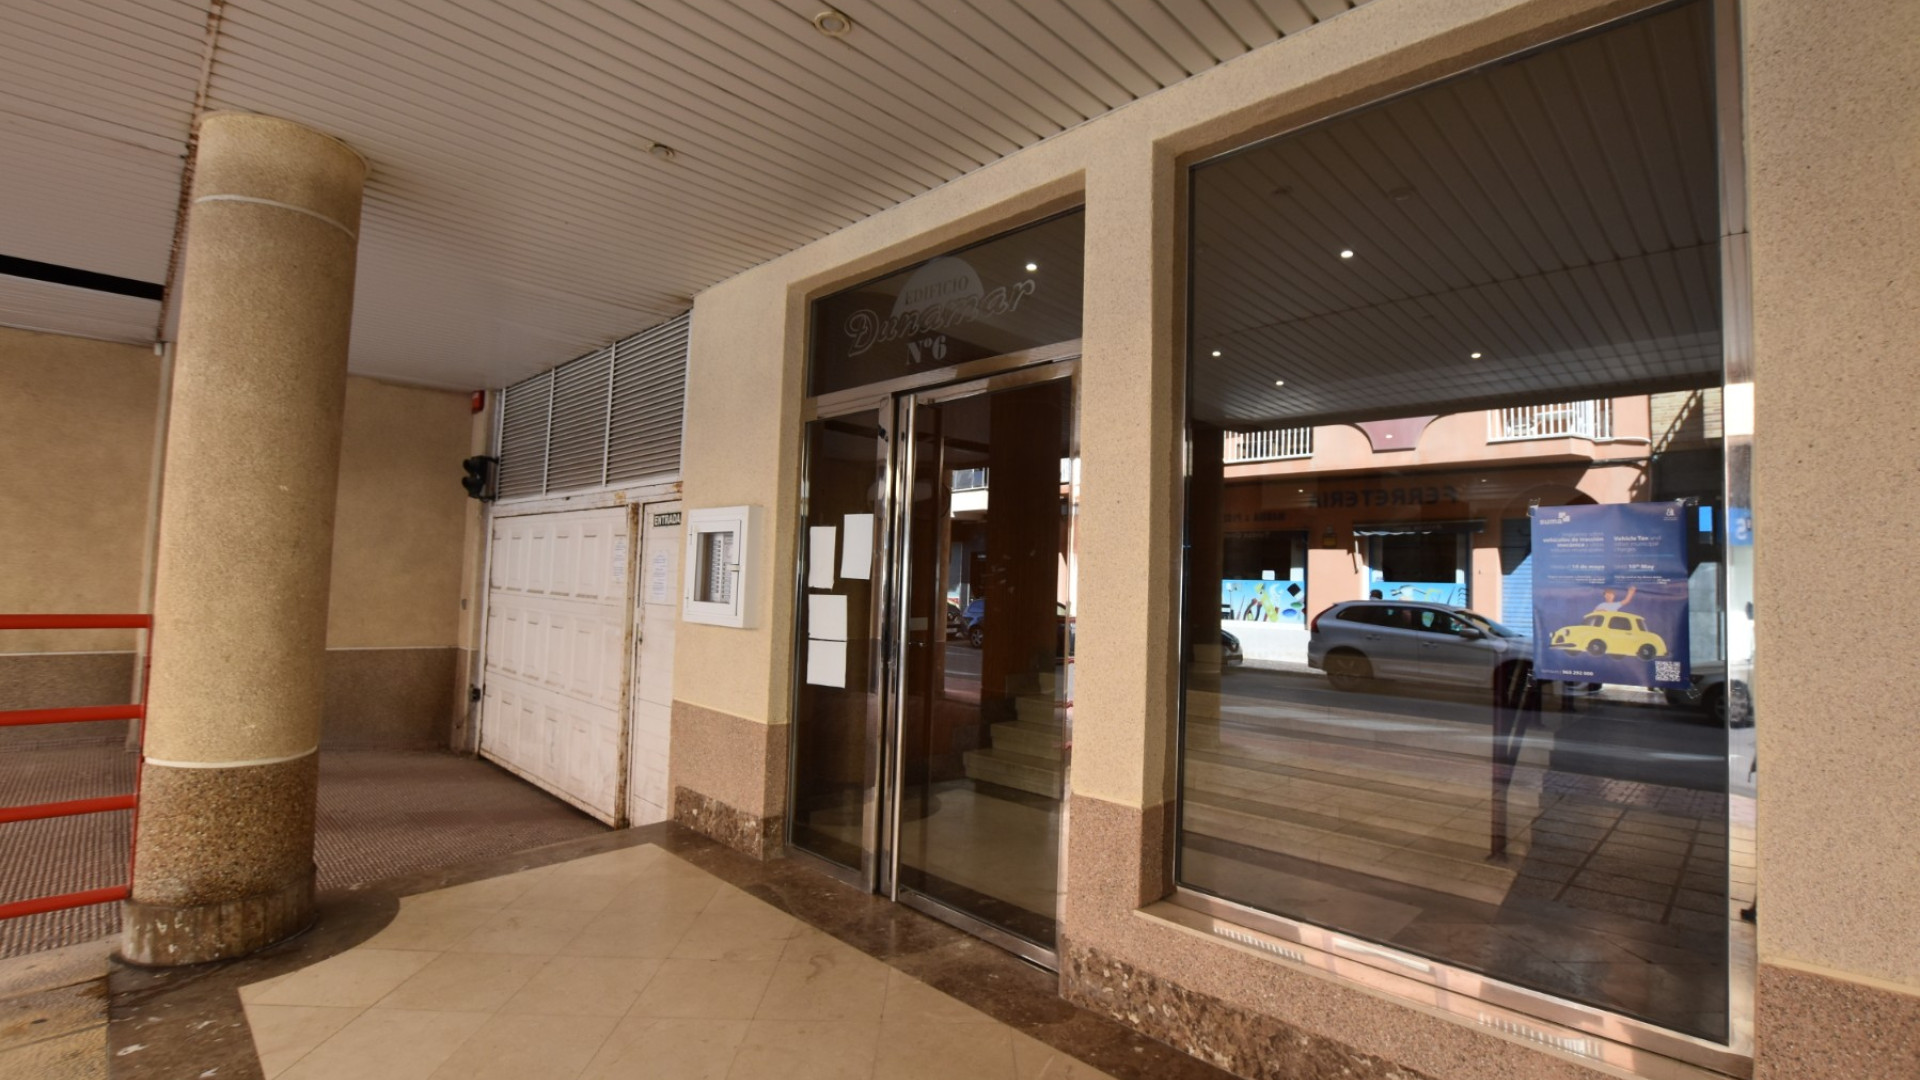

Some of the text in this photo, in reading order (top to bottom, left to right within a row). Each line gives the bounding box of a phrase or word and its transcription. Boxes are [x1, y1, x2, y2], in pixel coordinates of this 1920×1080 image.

[905, 276, 969, 305] EDIFICIO
[844, 279, 1036, 358] Dunamar
[654, 512, 681, 526] ENTRADA
